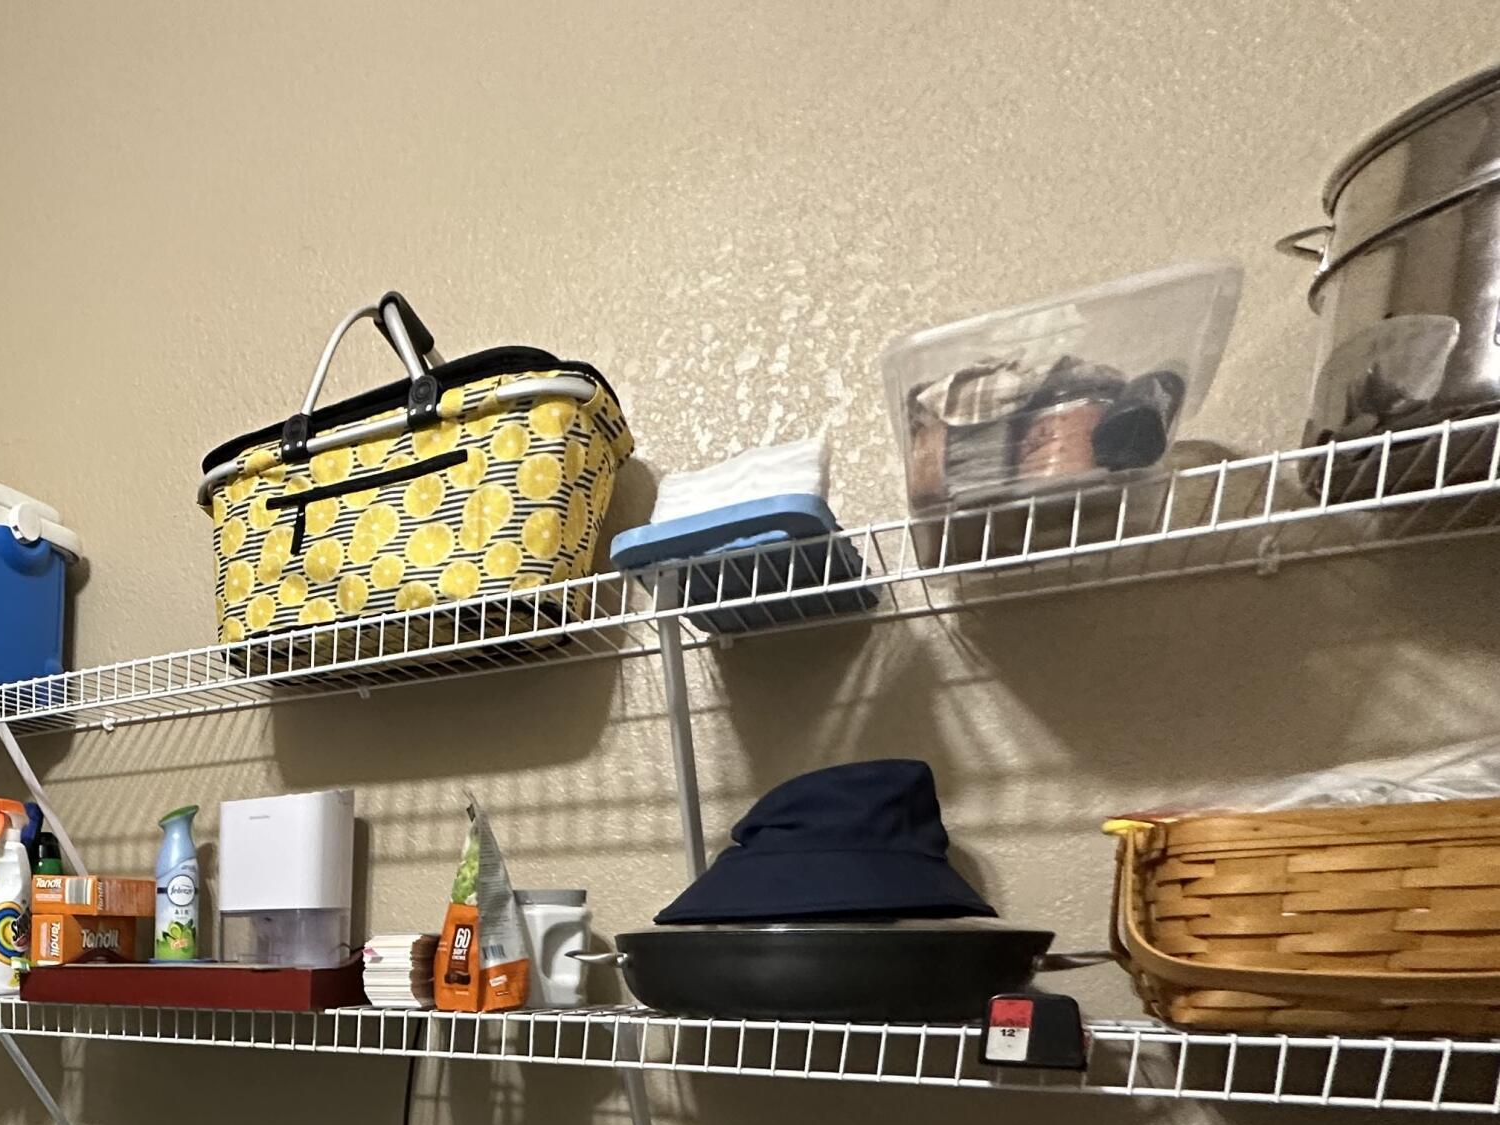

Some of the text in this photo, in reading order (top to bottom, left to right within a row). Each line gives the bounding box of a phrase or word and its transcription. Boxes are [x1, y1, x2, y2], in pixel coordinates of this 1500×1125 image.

[35, 876, 62, 888] Tandil
[50, 922, 61, 957] Tandil
[80, 928, 119, 950] Tandil
[454, 927, 471, 949] 60
[1000, 1028, 1016, 1037] 12
